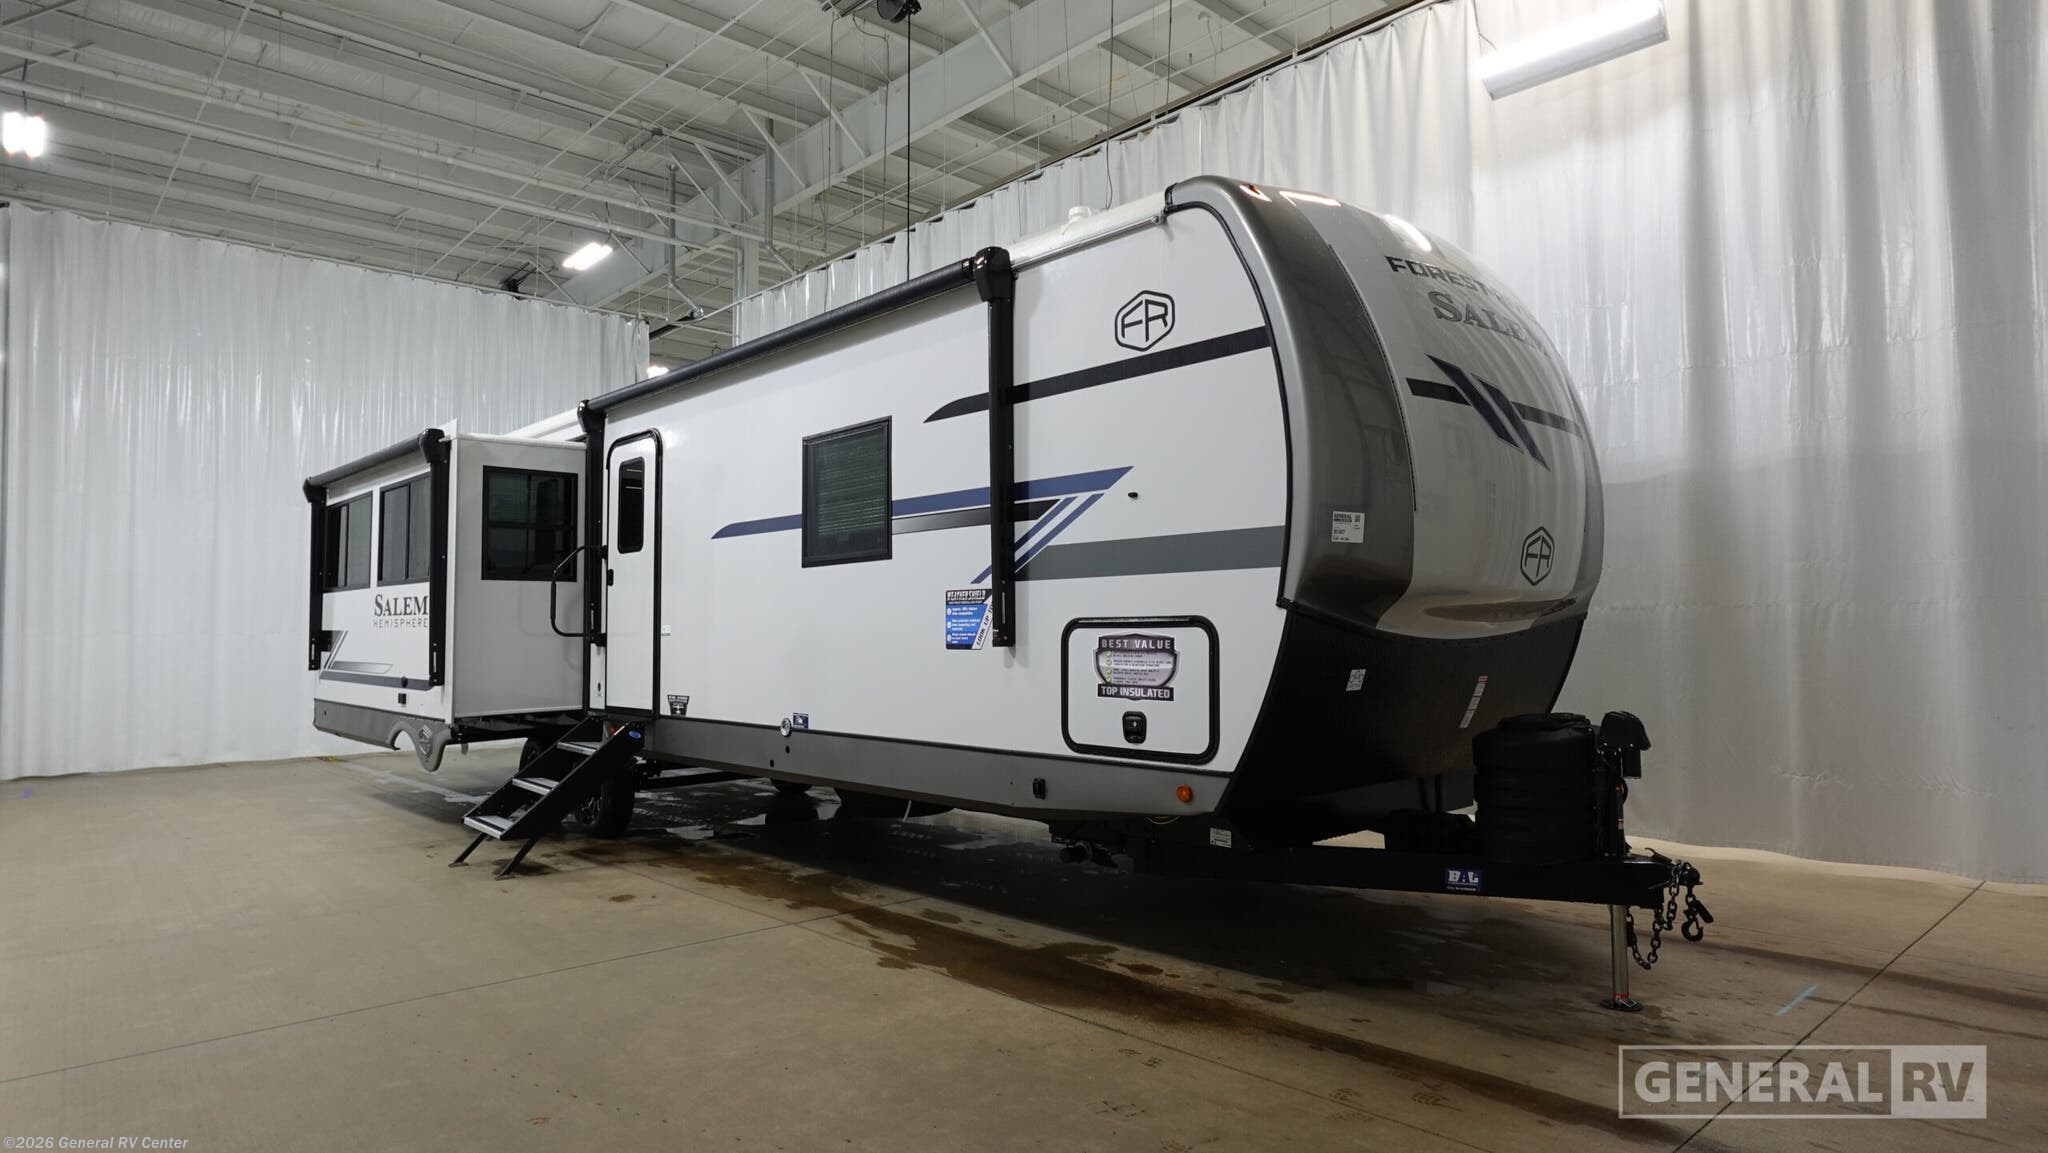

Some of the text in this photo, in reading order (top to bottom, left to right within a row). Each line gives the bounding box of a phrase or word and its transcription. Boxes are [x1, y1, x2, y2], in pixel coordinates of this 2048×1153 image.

[1384, 255, 1489, 296] FOREST
[374, 593, 429, 617] SALEM
[373, 617, 429, 629] HEMISPHERE
[1101, 639, 1171, 650] BEST VALUE
[1101, 686, 1170, 699] TOP INSULATED
